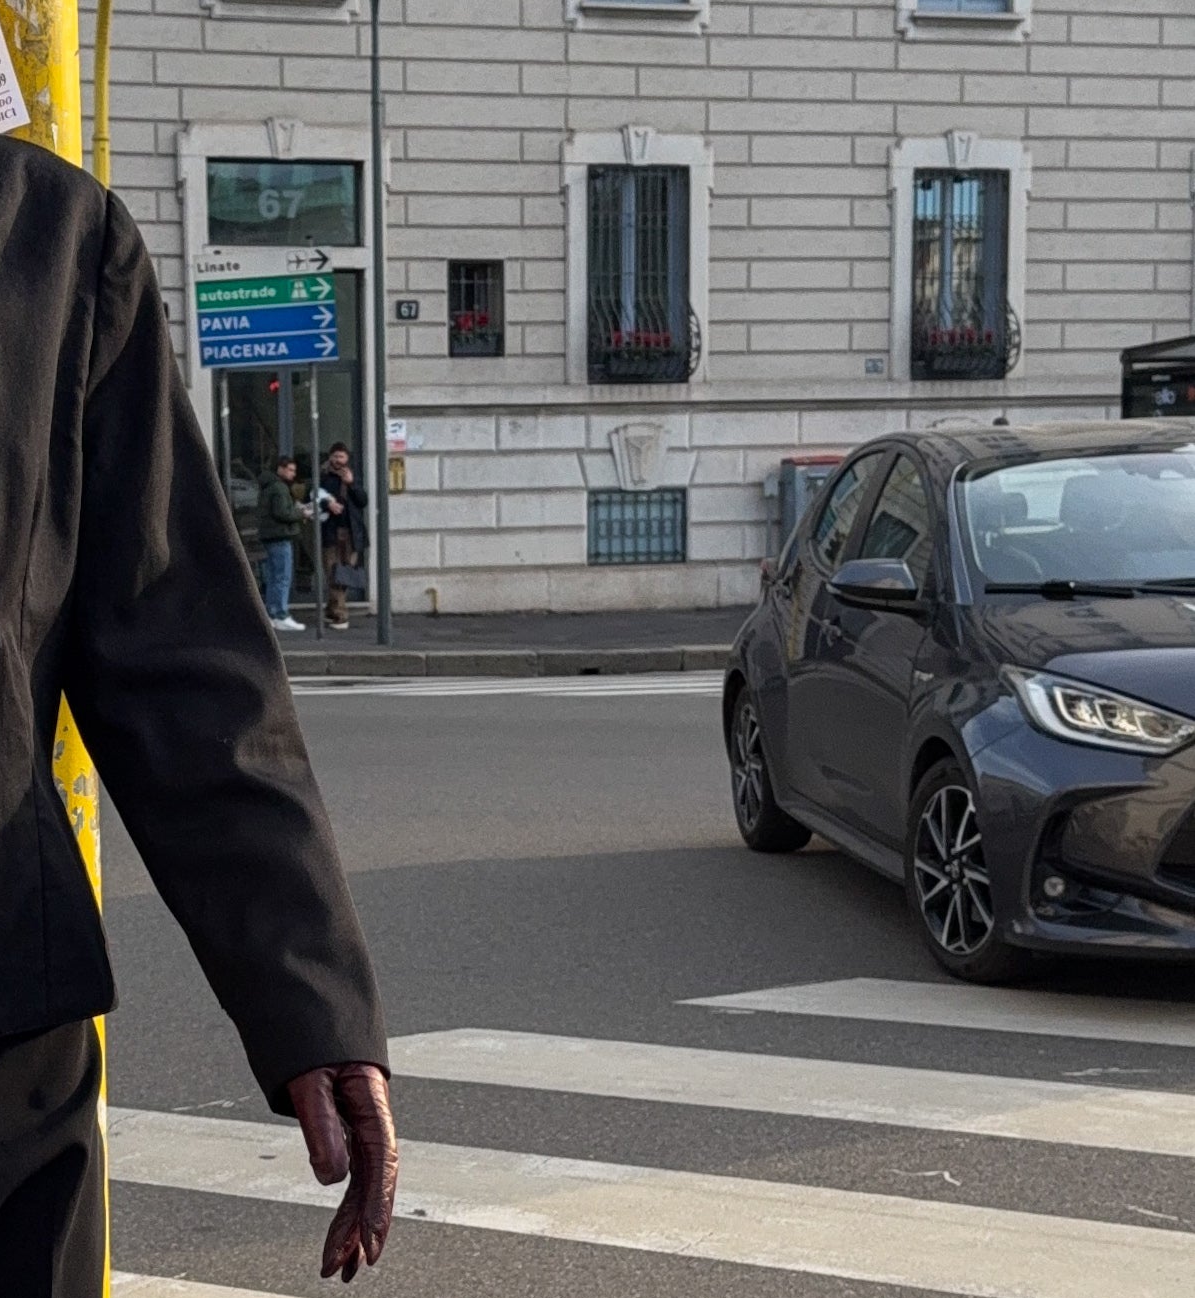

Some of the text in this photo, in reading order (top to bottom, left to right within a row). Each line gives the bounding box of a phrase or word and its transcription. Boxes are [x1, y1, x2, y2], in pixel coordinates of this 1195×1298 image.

[258, 189, 305, 220] 67
[197, 261, 240, 273] Linate
[199, 285, 276, 302] autostrade
[400, 302, 416, 318] 67
[201, 315, 250, 331] PAVIA
[203, 342, 289, 360] PIACENZA
